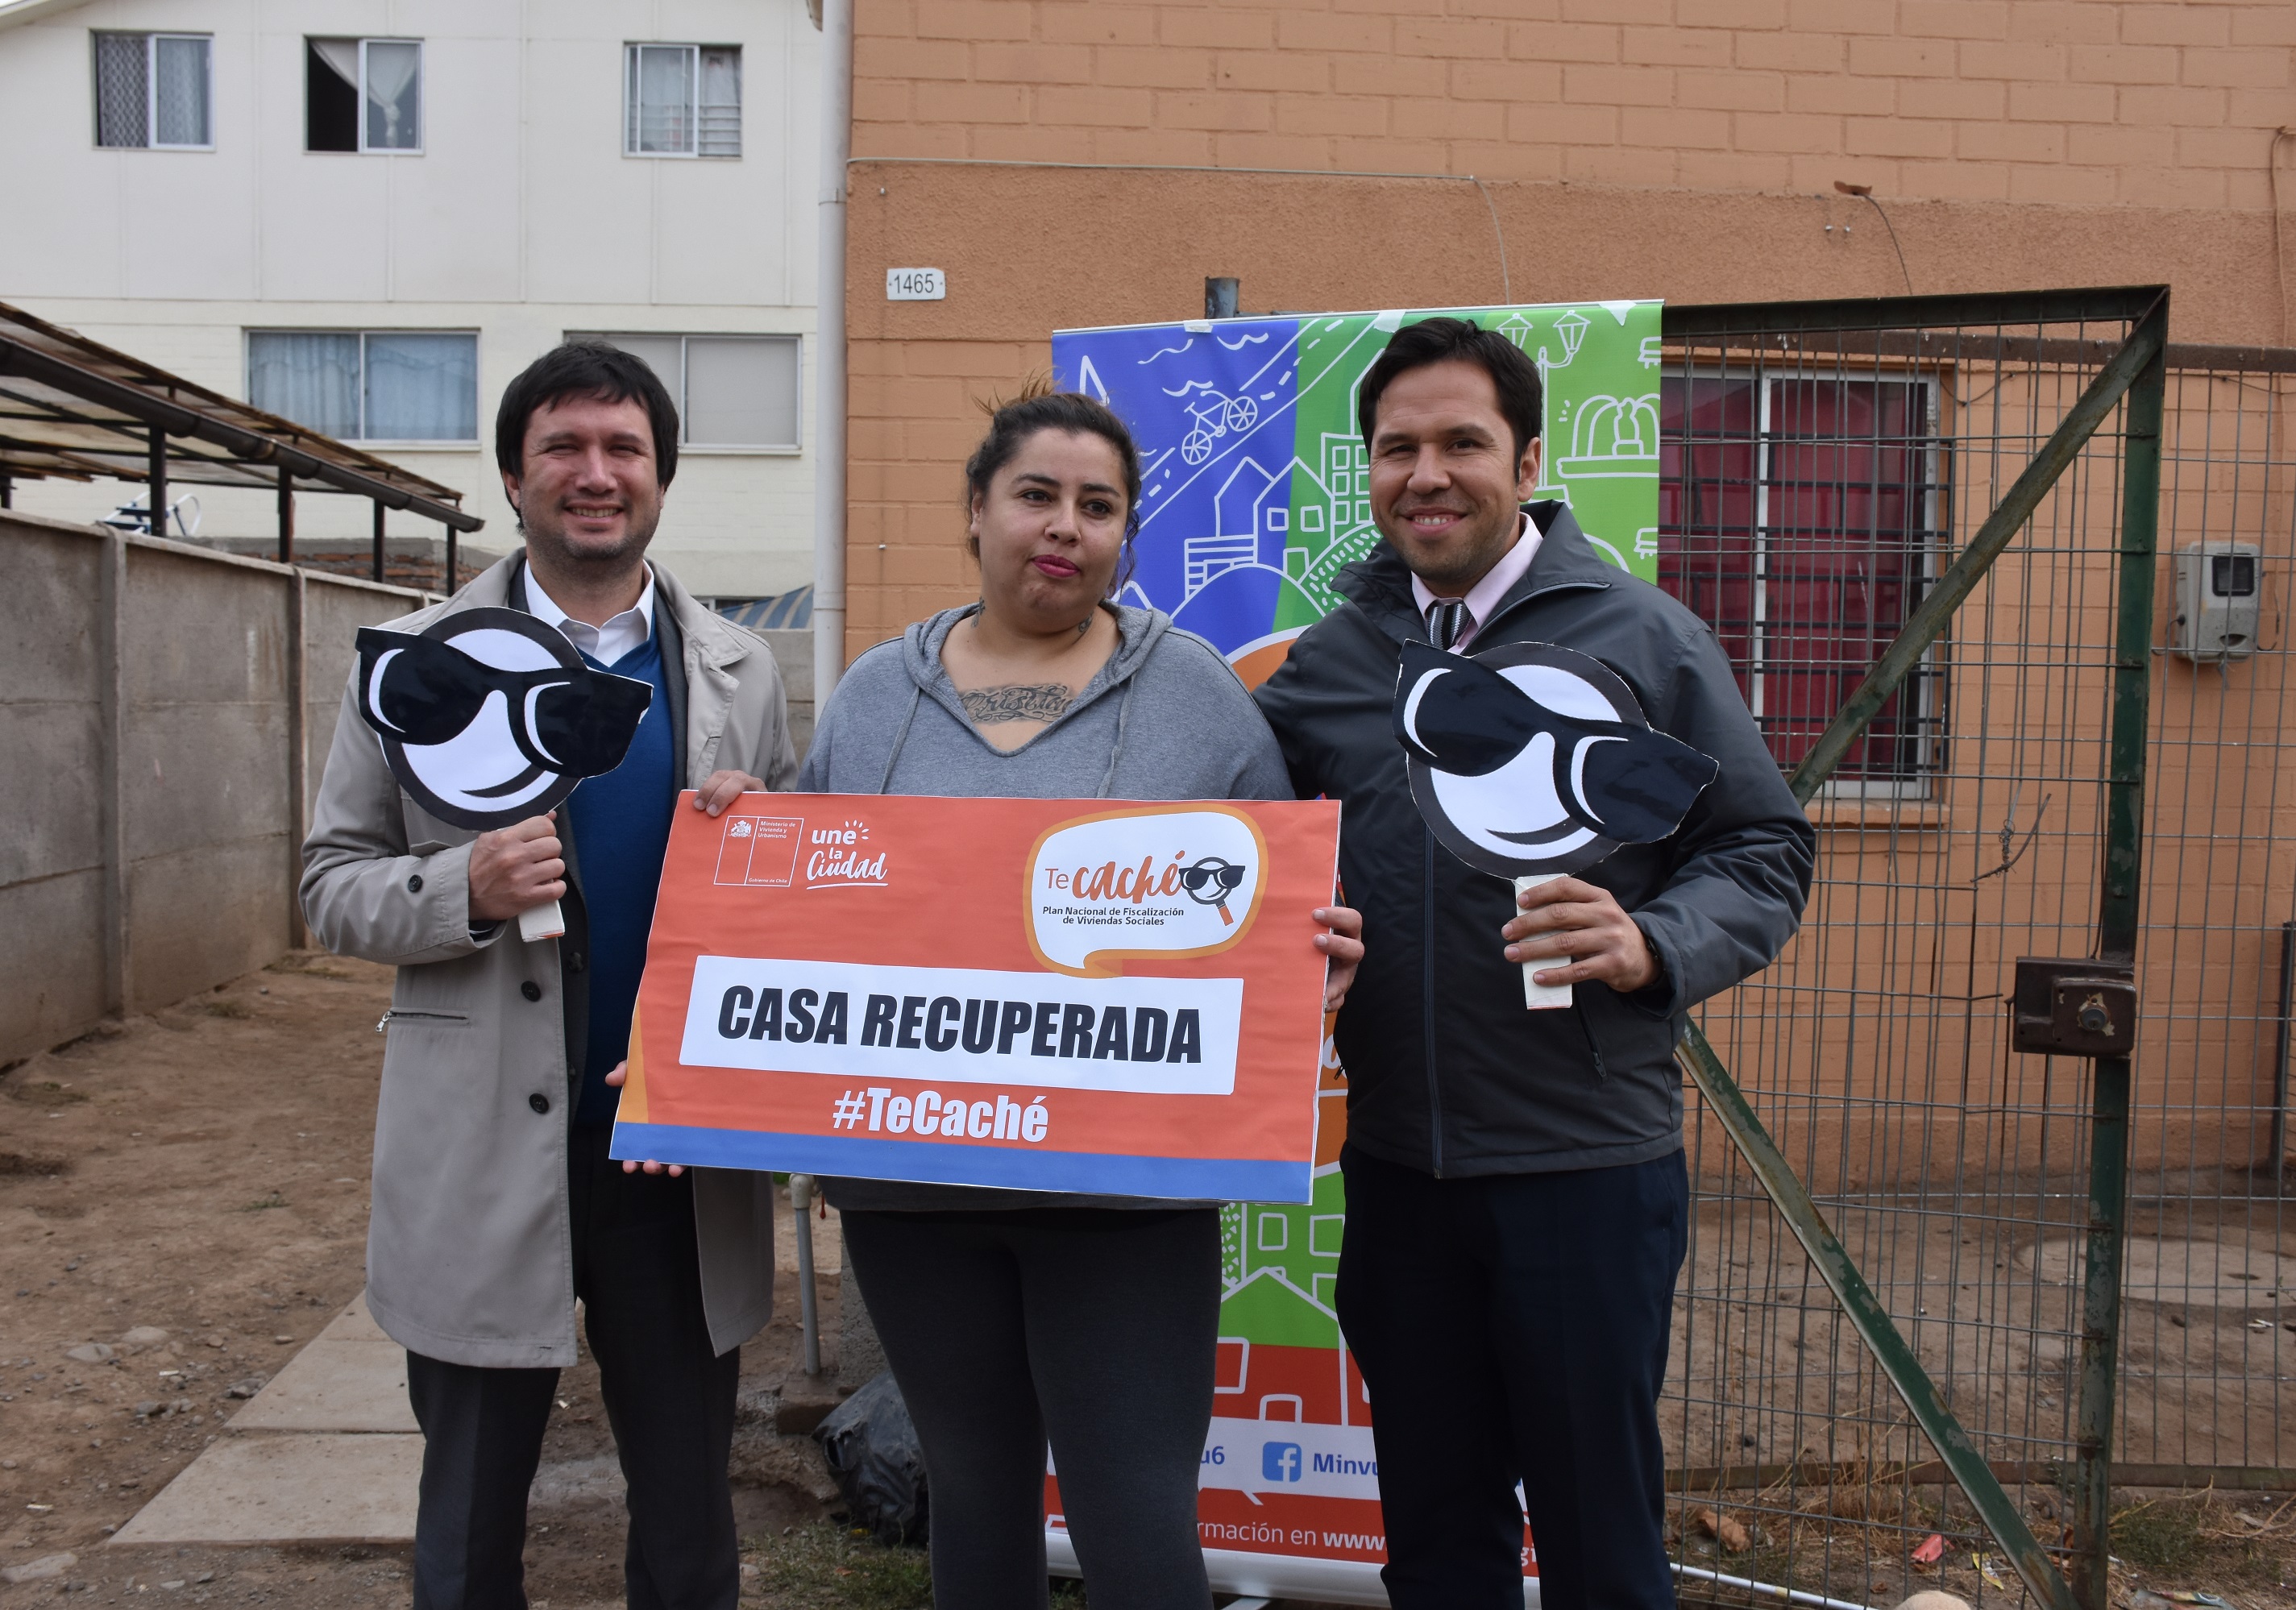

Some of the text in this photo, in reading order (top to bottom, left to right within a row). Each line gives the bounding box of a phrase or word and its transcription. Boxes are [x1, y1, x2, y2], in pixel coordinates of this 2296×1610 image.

[894, 273, 934, 293] 1465
[811, 828, 857, 844] une
[828, 847, 843, 860] la
[806, 850, 888, 880] Ciudad
[1044, 849, 1185, 904] Te caché
[1043, 906, 1185, 917] Plan Nacional de Fiscalización
[1062, 915, 1165, 926] de Viviendas Sociales
[716, 984, 1203, 1064] CASA RECUPERADA
[832, 1086, 1049, 1143] #TeCaché
[1290, 1529, 1317, 1546] en
[1322, 1531, 1387, 1551] www
